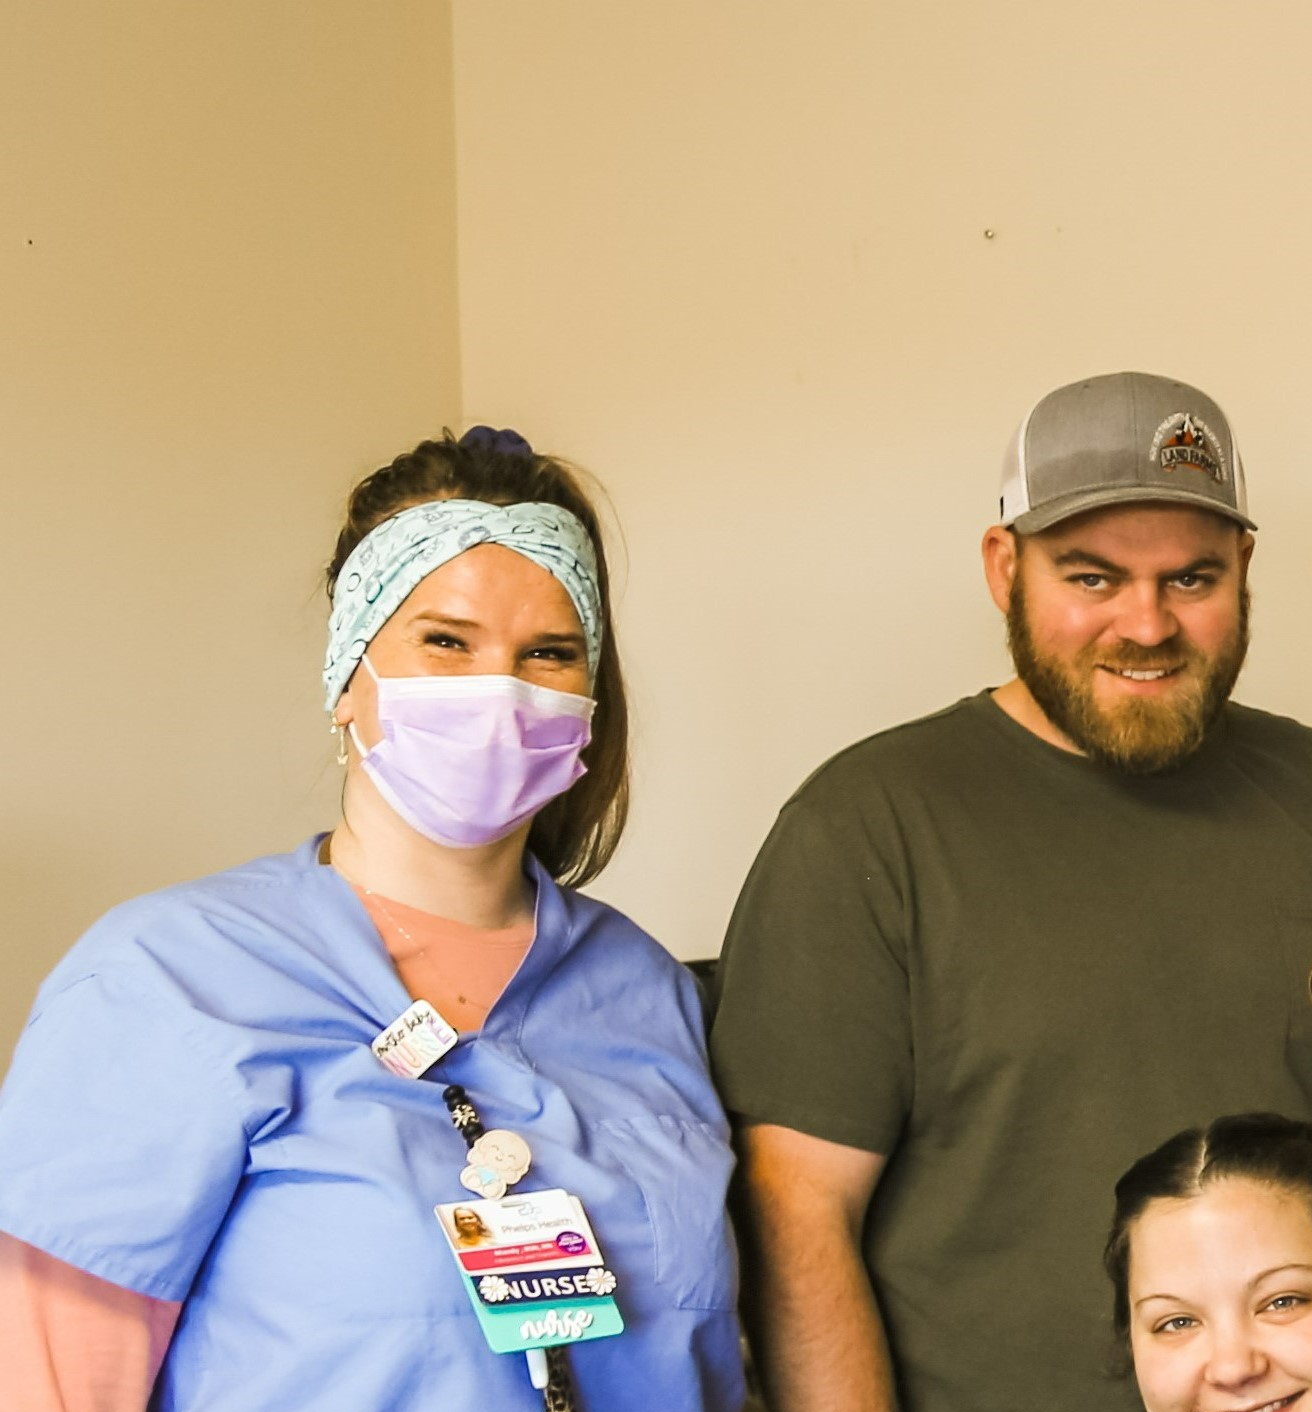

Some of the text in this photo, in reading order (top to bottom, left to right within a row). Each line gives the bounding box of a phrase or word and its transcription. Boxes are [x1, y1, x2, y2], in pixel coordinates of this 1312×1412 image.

[500, 1217, 573, 1234] Phelps Health
[505, 1274, 592, 1301] NURSE
[519, 1308, 594, 1340] nurse
